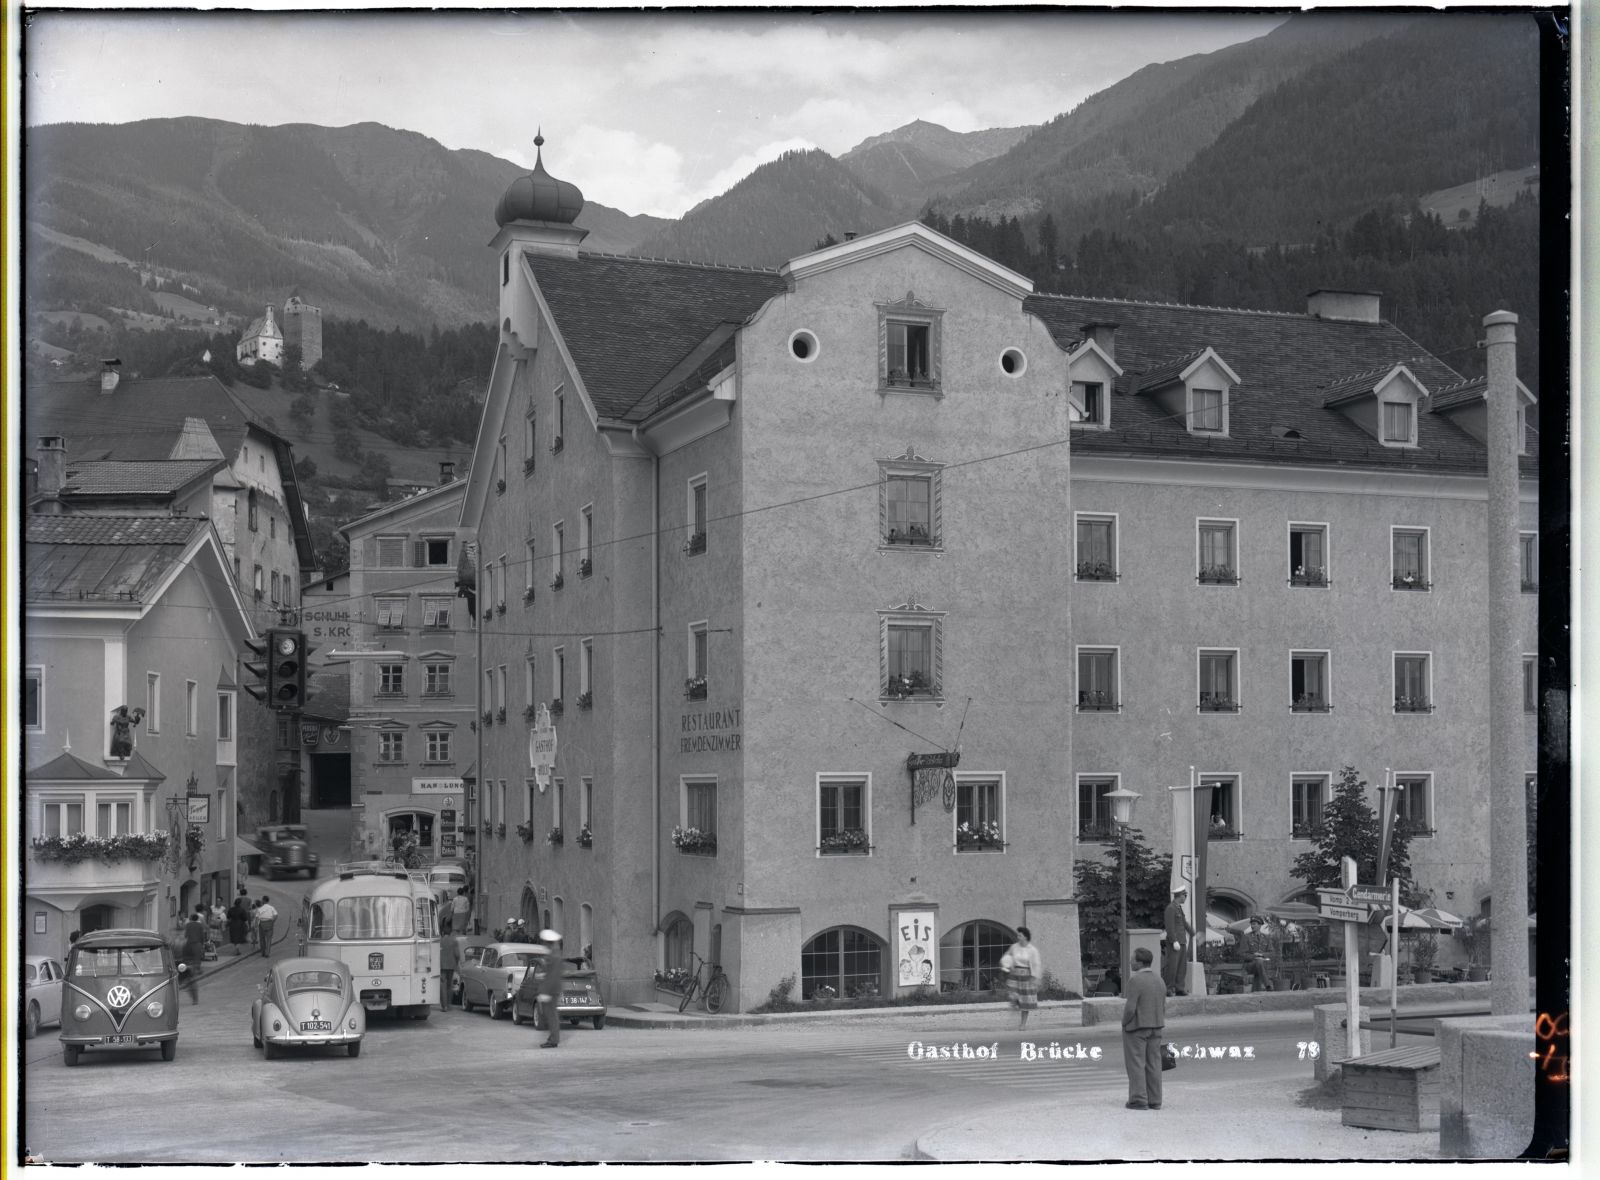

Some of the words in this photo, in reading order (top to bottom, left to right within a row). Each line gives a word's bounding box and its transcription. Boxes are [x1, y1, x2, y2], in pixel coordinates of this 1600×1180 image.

[681, 709, 740, 732] RESTAURANT
[680, 734, 741, 753] FREMDENZIMMER
[1352, 887, 1391, 901] Gendarmerie
[1329, 908, 1359, 920] Vomperberg
[302, 1022, 306, 1030] T
